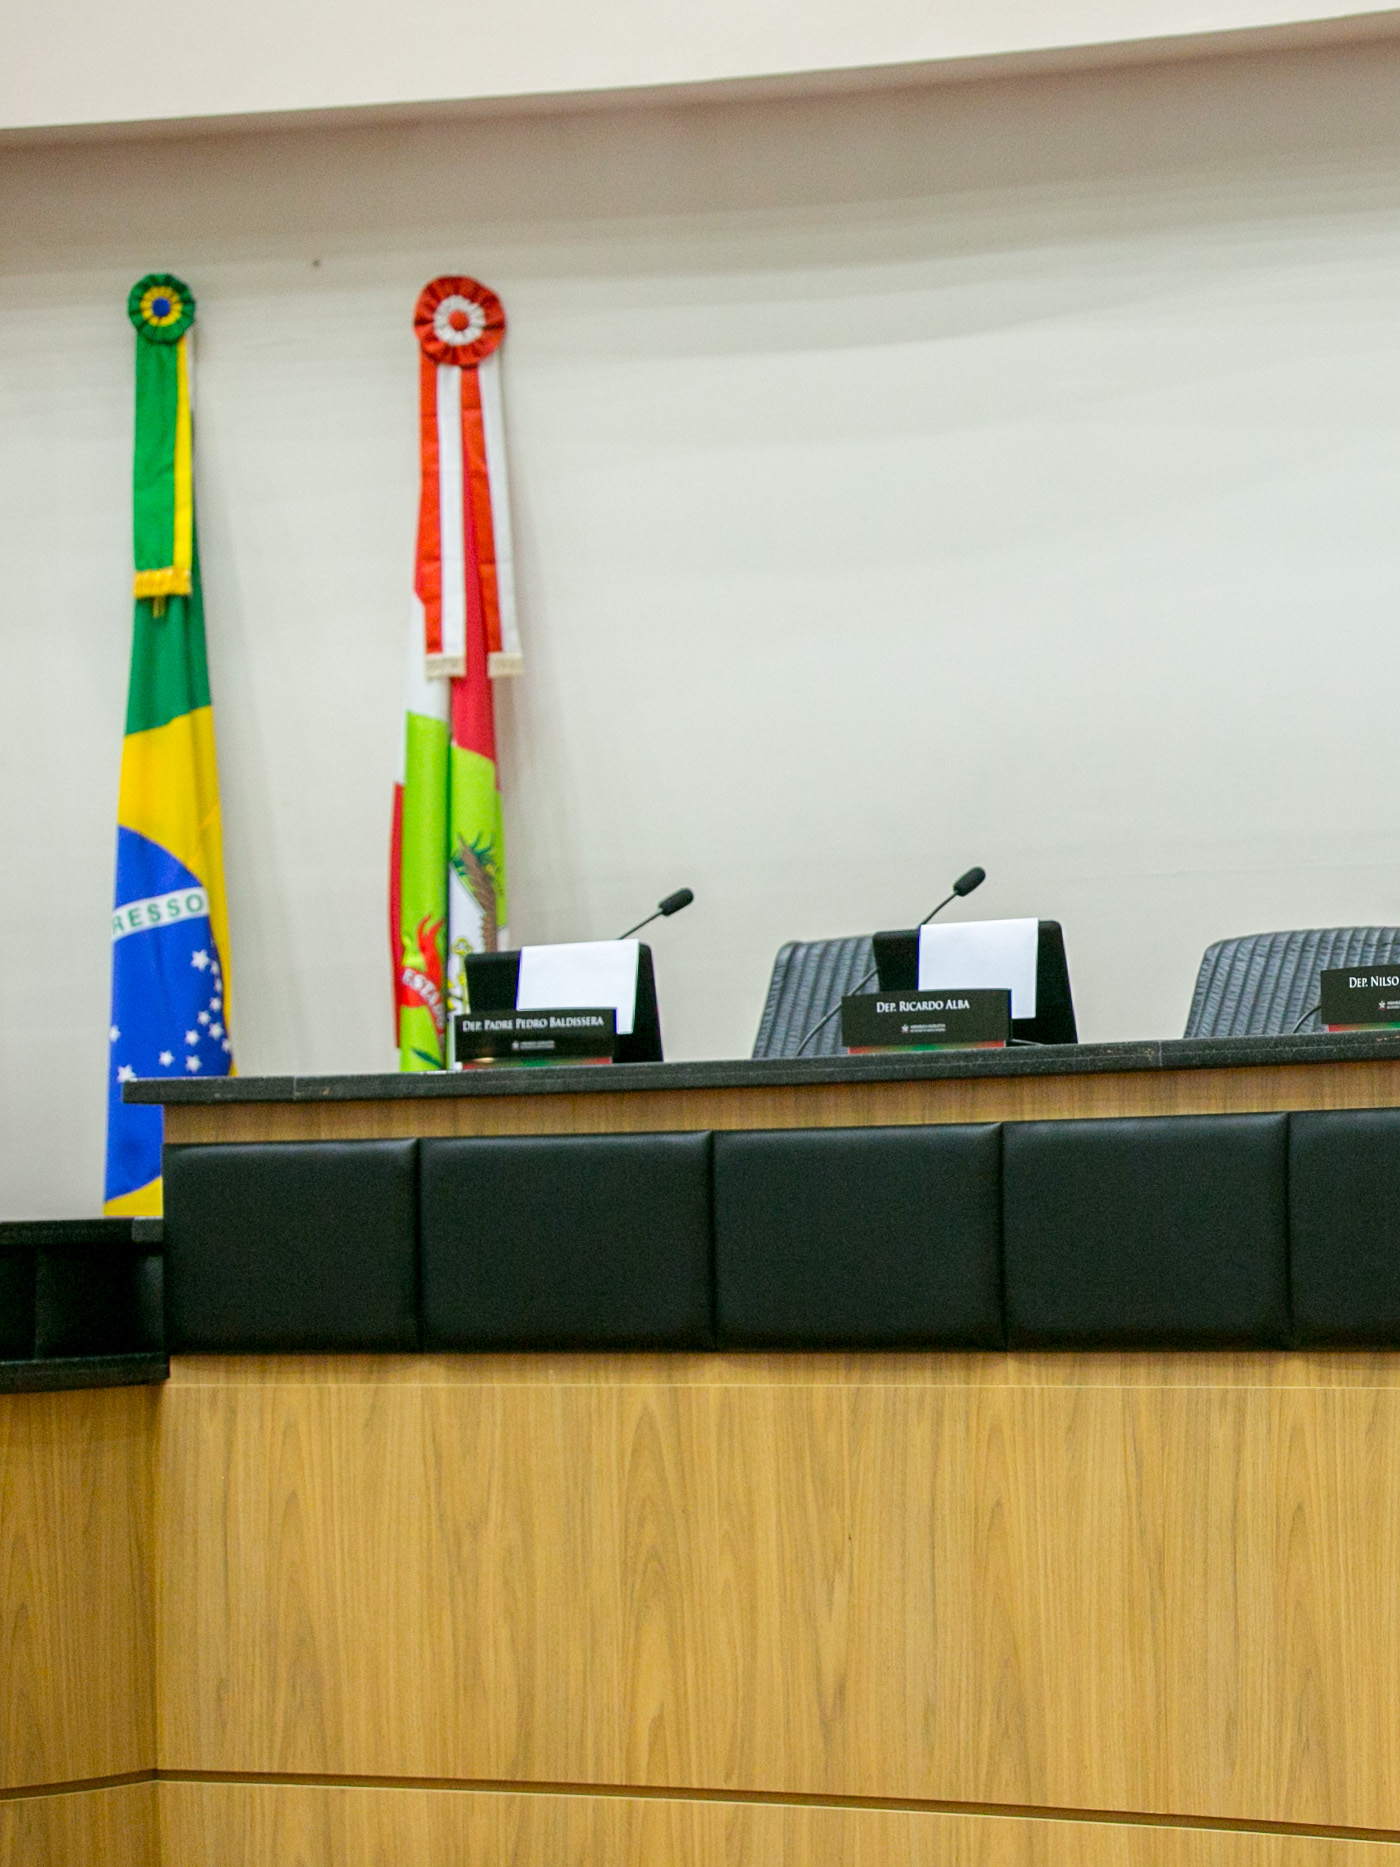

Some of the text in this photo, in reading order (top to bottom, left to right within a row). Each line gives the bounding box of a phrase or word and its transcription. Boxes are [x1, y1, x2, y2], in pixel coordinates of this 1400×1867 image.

[1370, 975, 1400, 987] NILSO
[899, 1000, 943, 1012] RICARDO
[945, 999, 970, 1010] ALBA
[484, 1019, 513, 1031] PADRE
[515, 1017, 548, 1029] PEDRO
[549, 1015, 604, 1027] BALDISSERA
